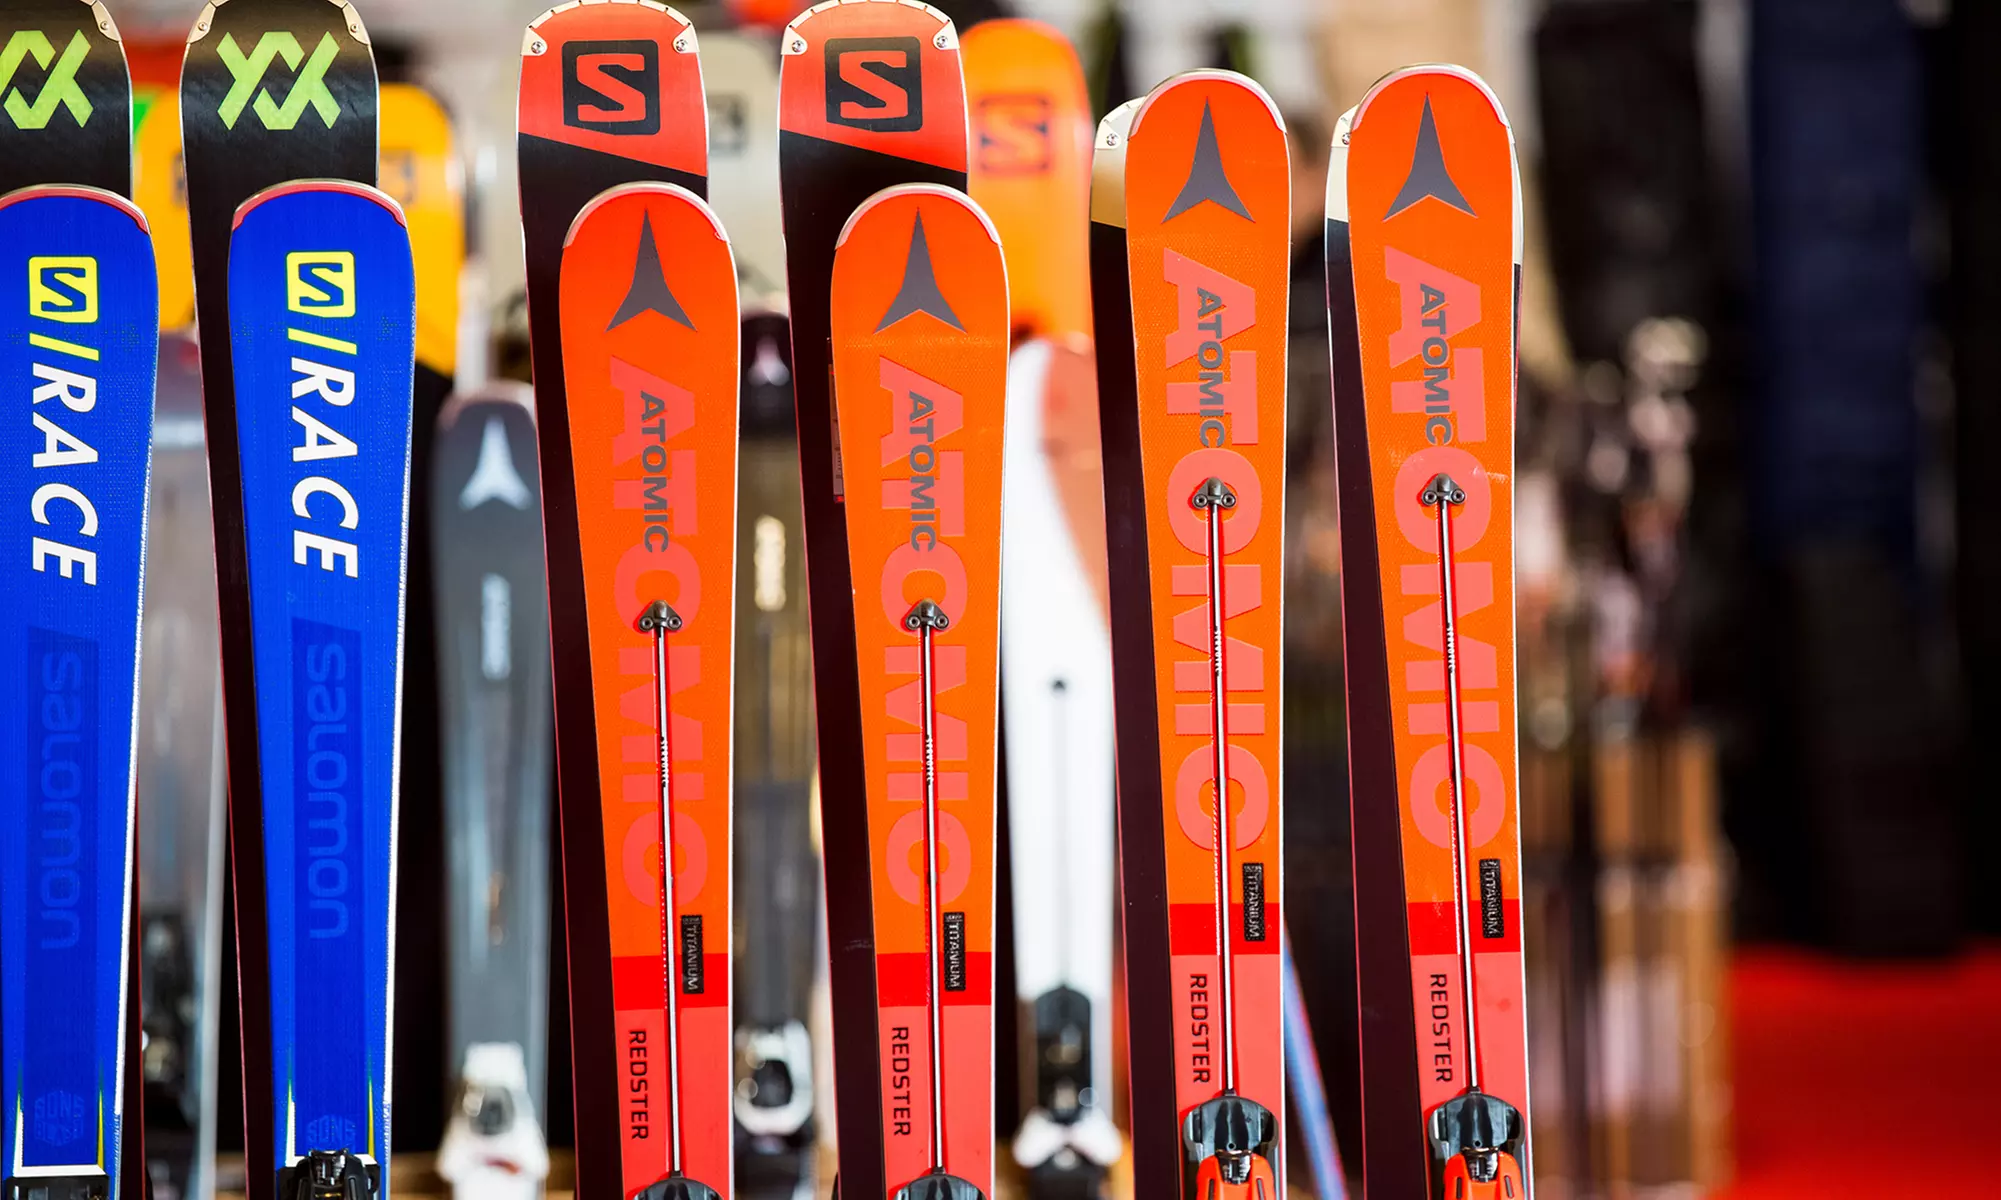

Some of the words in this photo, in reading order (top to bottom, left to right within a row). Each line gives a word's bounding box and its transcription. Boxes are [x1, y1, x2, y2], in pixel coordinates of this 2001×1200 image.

[574, 51, 648, 123] S
[838, 48, 910, 120] S
[1196, 286, 1226, 449] ATOMIC
[1419, 282, 1453, 447] ATOMIC
[640, 389, 669, 553] ATOMIC
[908, 391, 937, 553] ATOMIC
[686, 925, 699, 990] TITANIUM
[948, 922, 961, 988] TITANIUM
[1247, 873, 1260, 938] TITANIUM
[1485, 871, 1499, 935] TITANIUM
[891, 1026, 911, 1138] REDSTER
[1190, 974, 1211, 1084] REDSTER
[1430, 973, 1453, 1083] REDSTER
[628, 1029, 649, 1141] REDSTER
